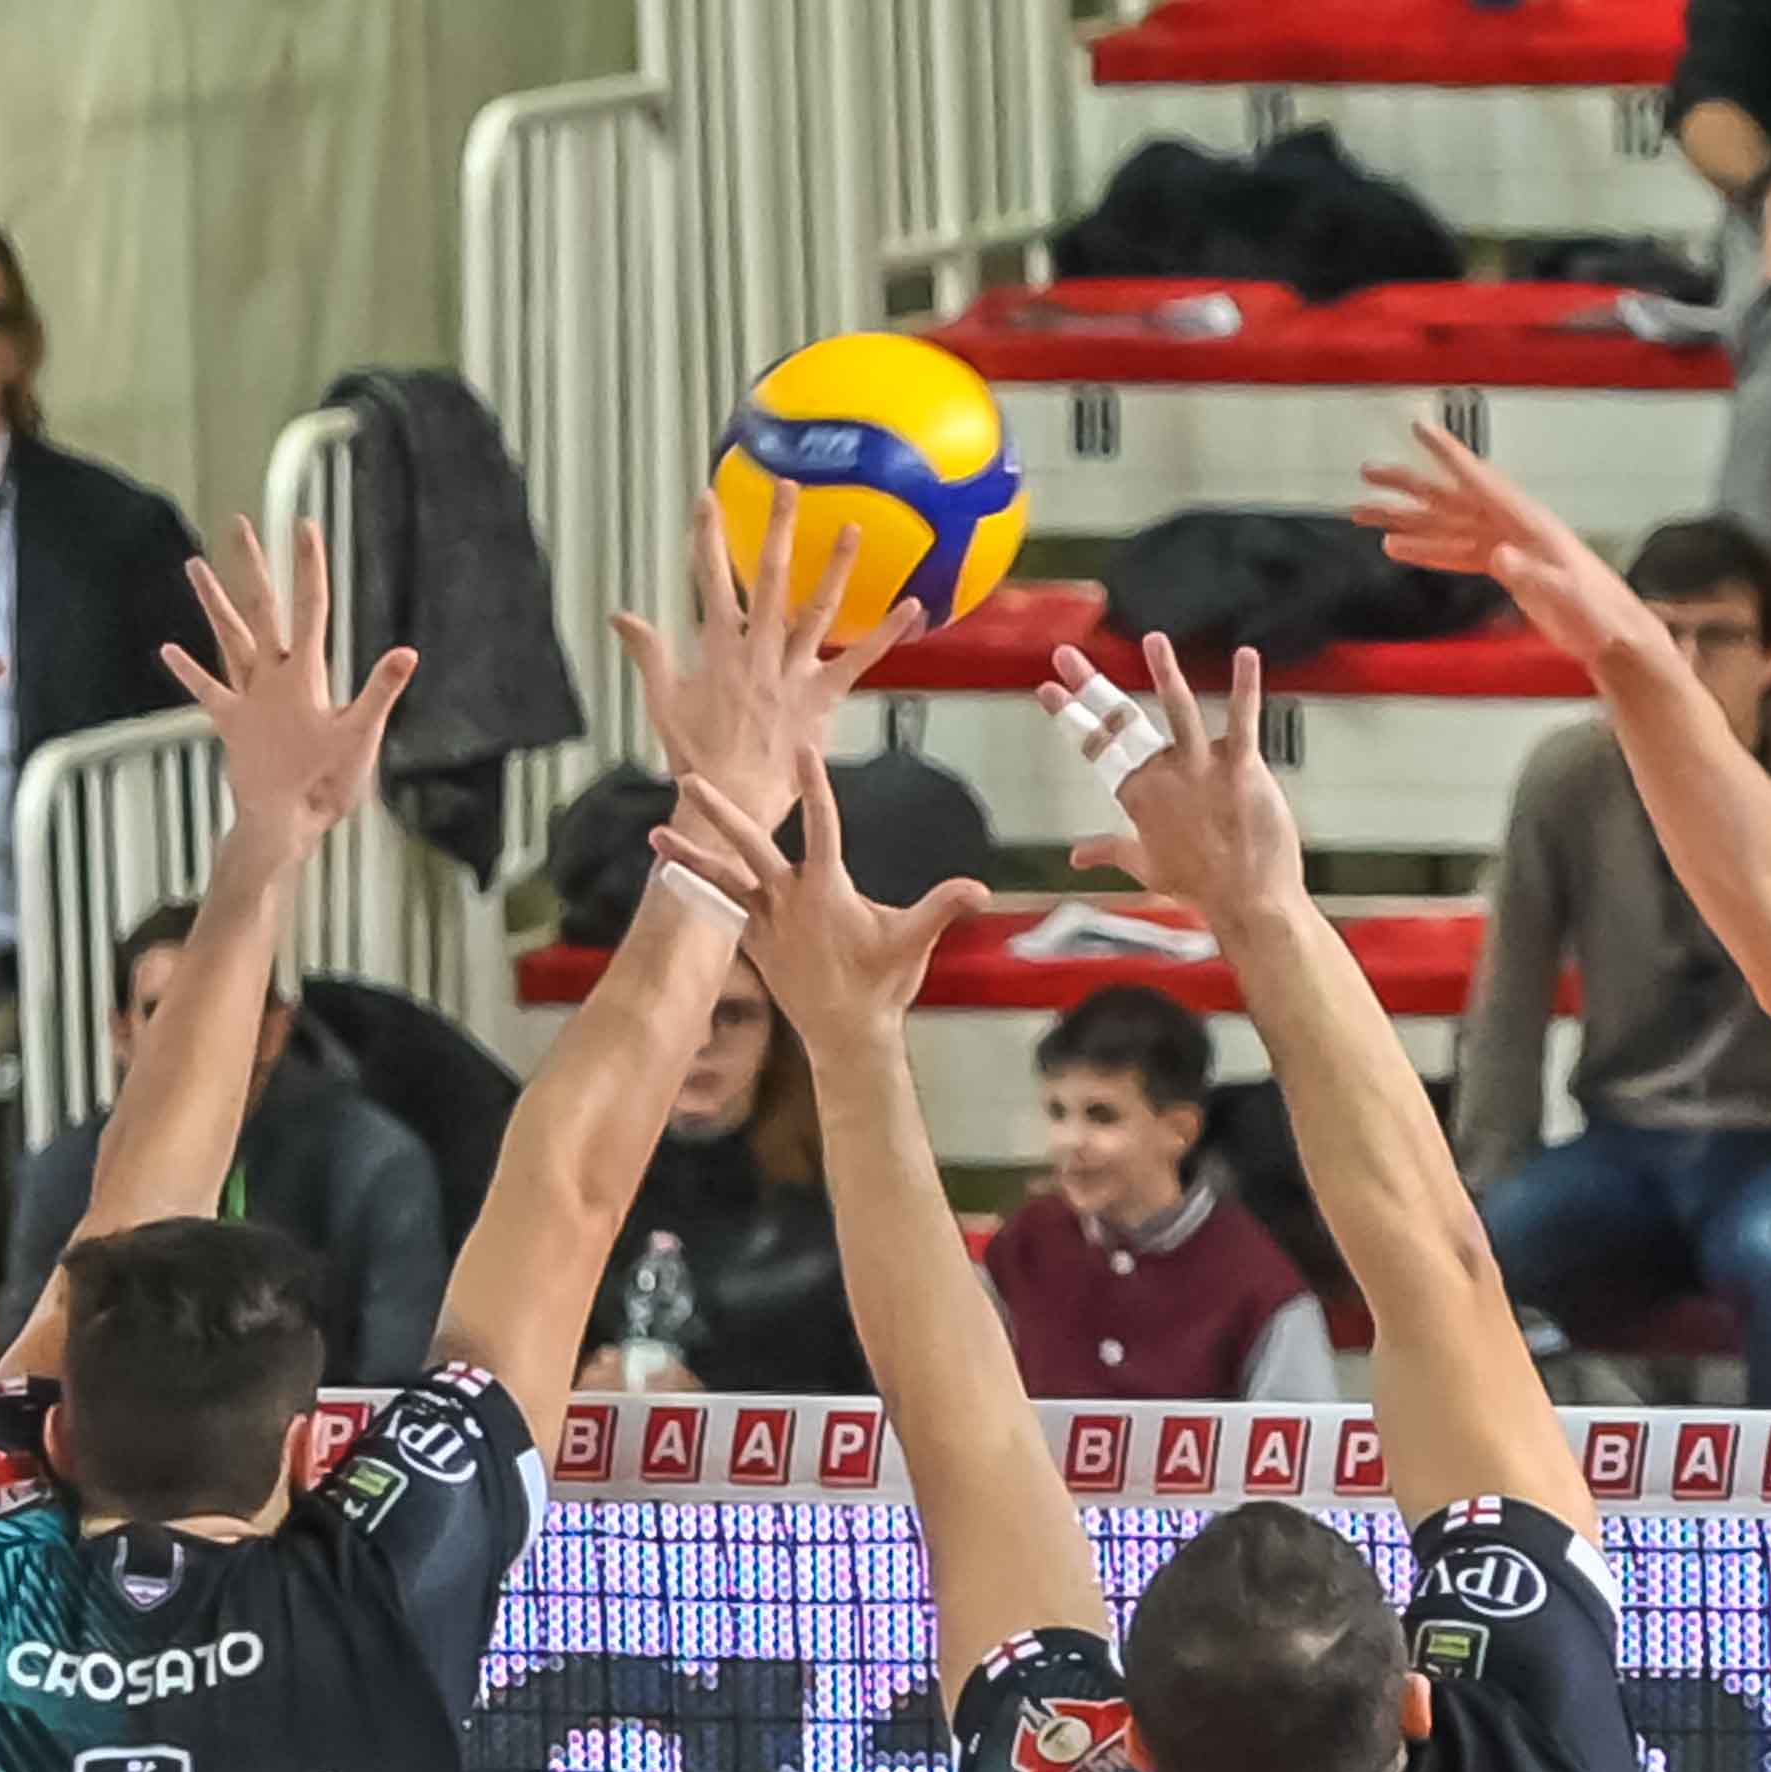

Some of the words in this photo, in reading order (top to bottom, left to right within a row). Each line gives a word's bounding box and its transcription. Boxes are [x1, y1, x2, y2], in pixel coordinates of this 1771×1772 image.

[558, 1410, 874, 1477] BAAP
[1071, 1422, 1384, 1486] BAAP
[6, 1631, 264, 1704] CROSATO
